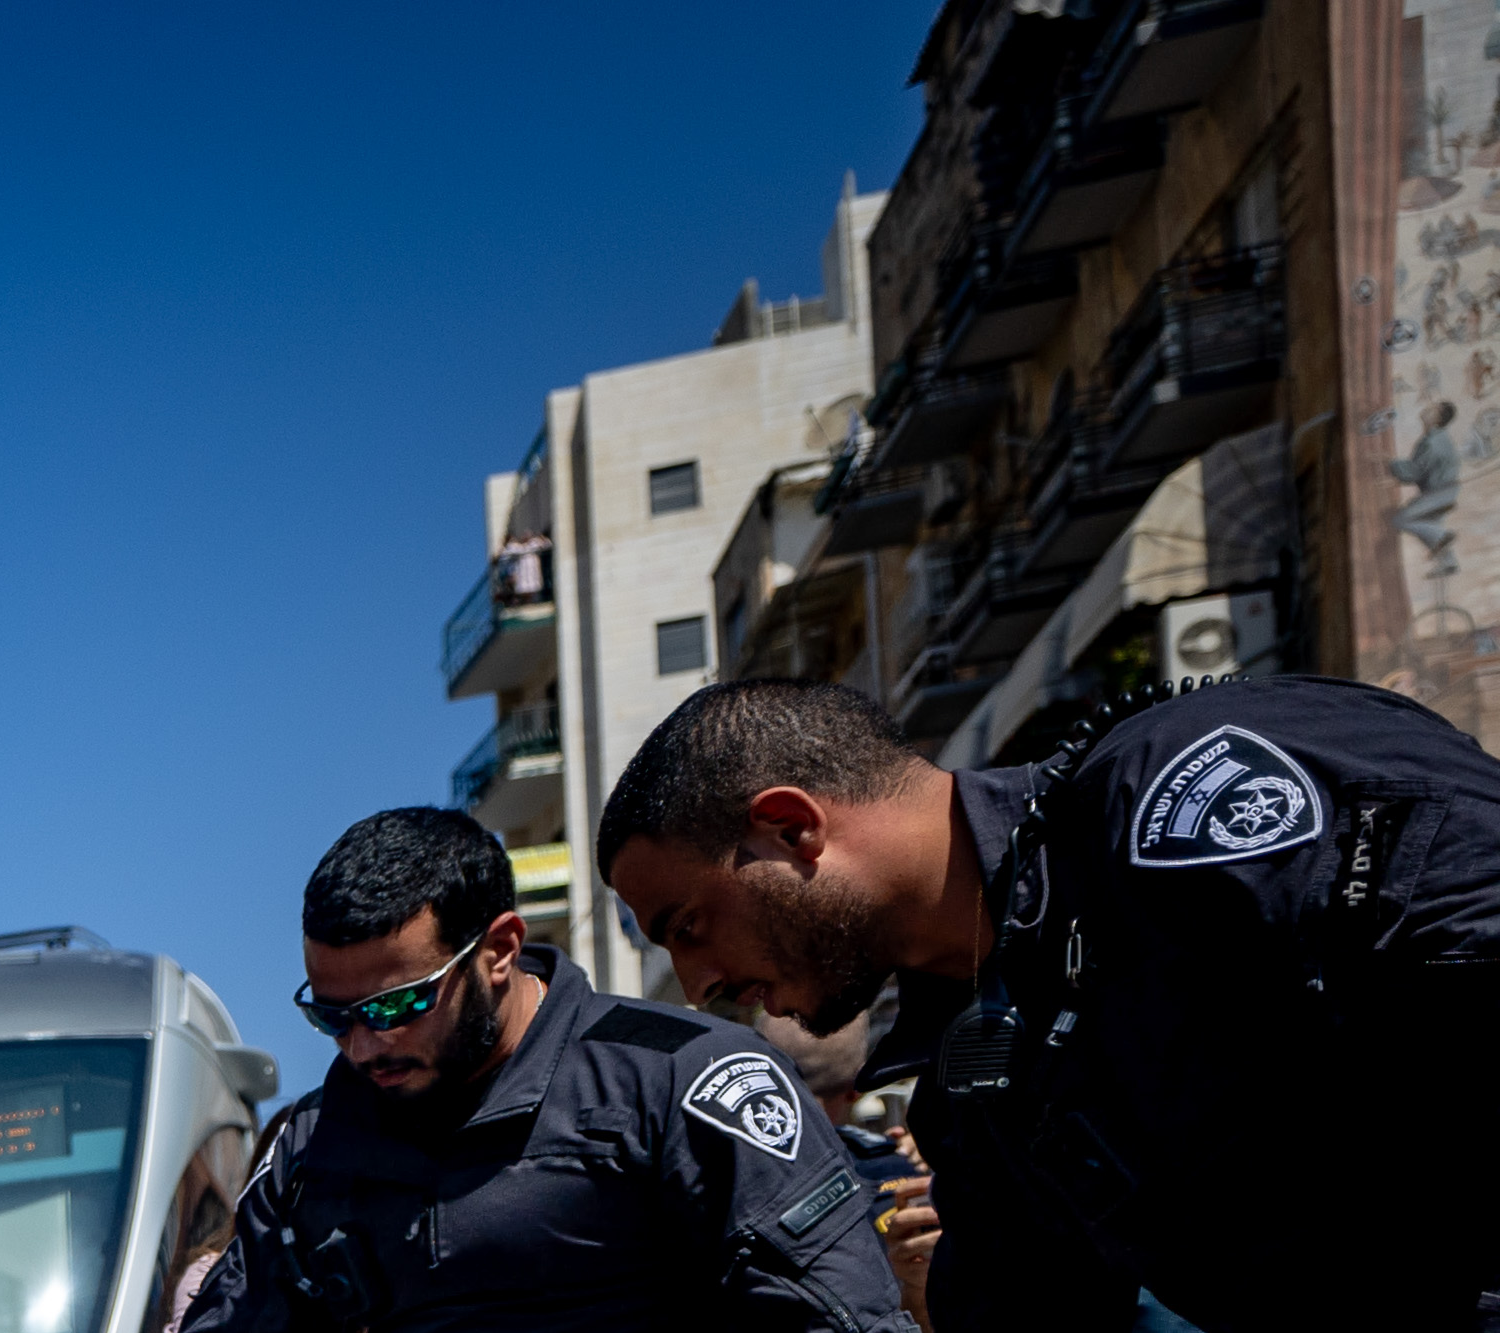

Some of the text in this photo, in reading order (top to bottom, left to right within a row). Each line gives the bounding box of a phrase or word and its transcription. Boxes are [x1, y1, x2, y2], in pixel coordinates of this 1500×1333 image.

[1141, 740, 1230, 849] משטרת ישראל
[1342, 880, 1368, 907] לוי
[693, 1060, 771, 1102] משטרת ישראל
